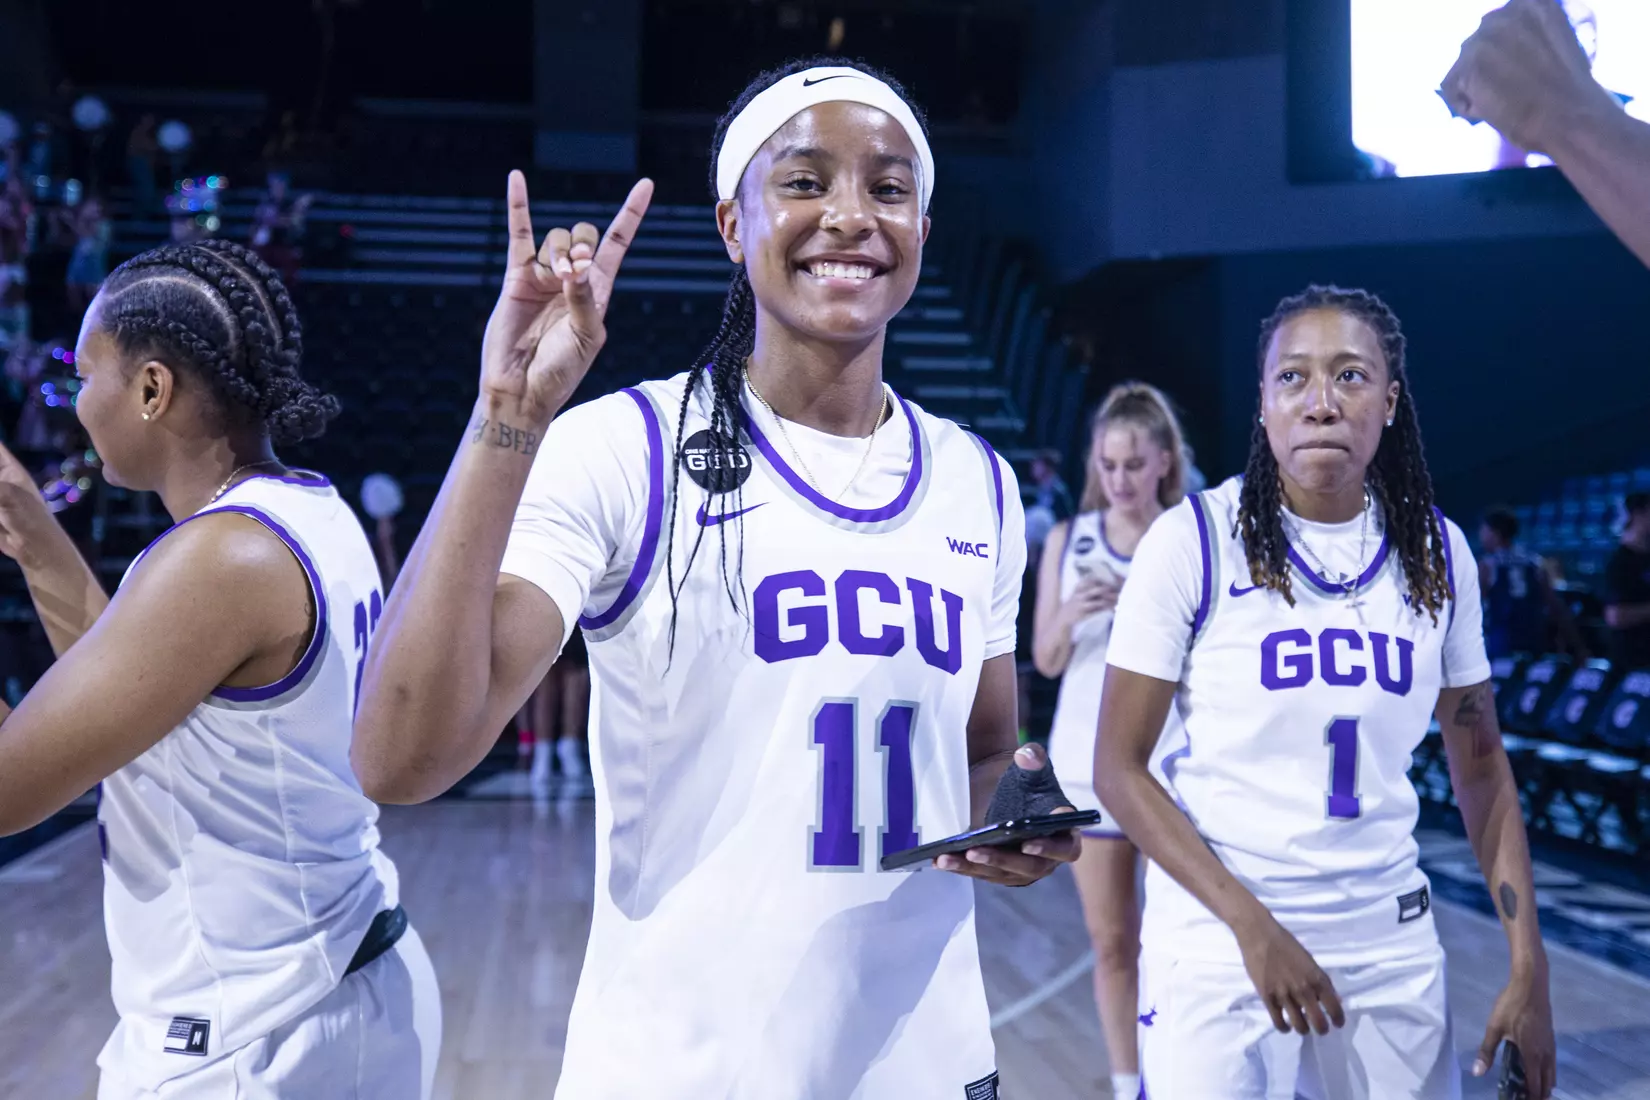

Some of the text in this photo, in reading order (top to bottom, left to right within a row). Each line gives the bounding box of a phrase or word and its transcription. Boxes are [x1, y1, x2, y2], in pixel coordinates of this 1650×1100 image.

[946, 536, 988, 558] WAC
[753, 569, 963, 675] GCU
[1260, 628, 1414, 697] GCU
[806, 696, 922, 873] 11
[1323, 715, 1363, 821] 1
